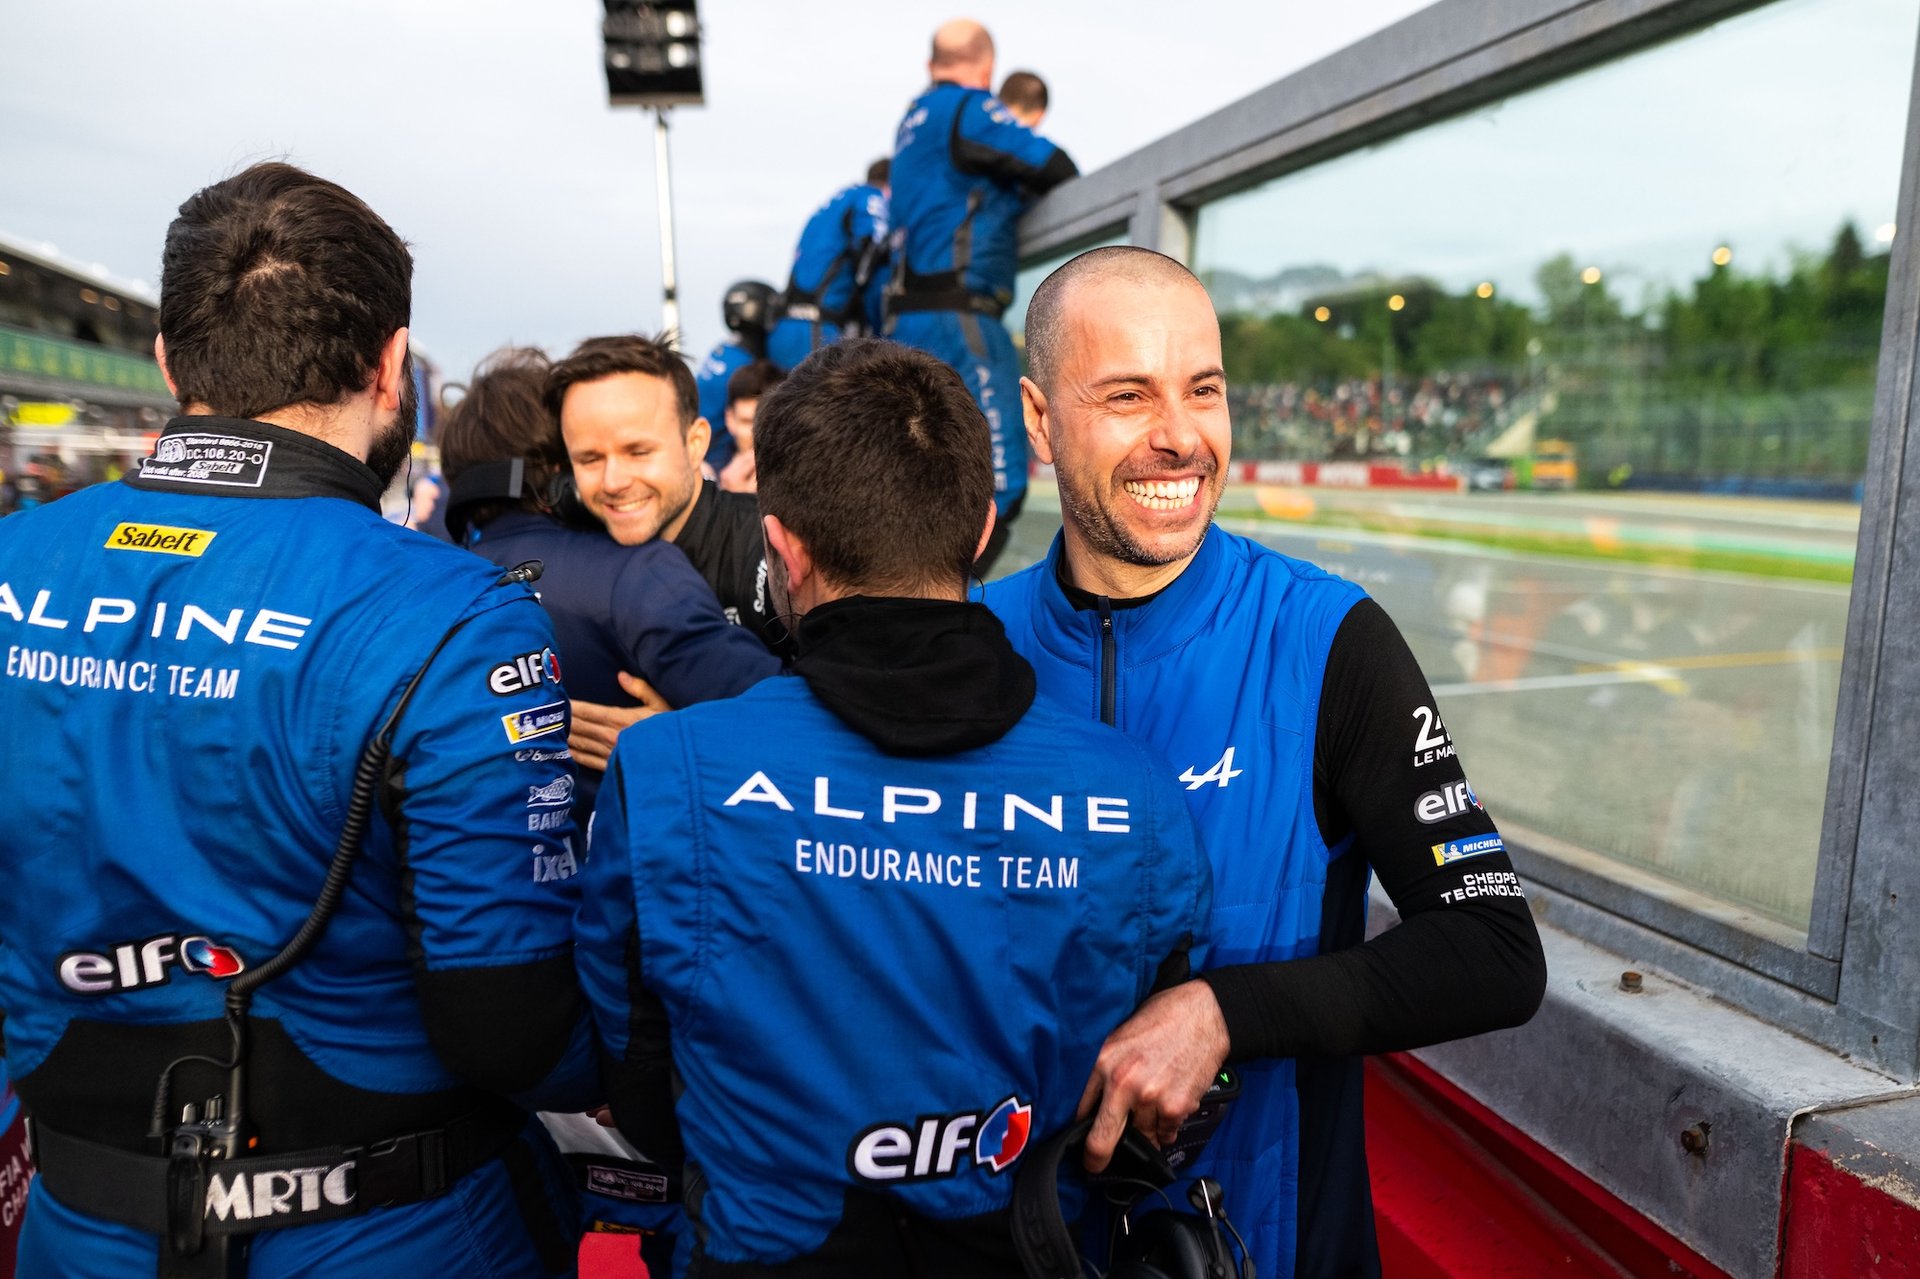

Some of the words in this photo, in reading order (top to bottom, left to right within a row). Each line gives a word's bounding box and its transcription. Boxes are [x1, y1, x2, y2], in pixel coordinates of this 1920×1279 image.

[195, 461, 237, 473] Sabelt
[117, 526, 199, 552] Sabelt
[167, 664, 241, 700] TEAM
[489, 653, 543, 694] elf
[1413, 750, 1434, 768] LE
[722, 770, 1131, 834] ALPINE
[1417, 782, 1468, 821] elf
[795, 838, 981, 888] ENDURANCE
[998, 856, 1080, 889] TEAM
[1462, 872, 1517, 886] CHEOPS
[1440, 884, 1525, 905] TECHNOLO
[60, 935, 175, 992] elf
[854, 1114, 977, 1180] elf
[204, 1160, 357, 1222] MRTC
